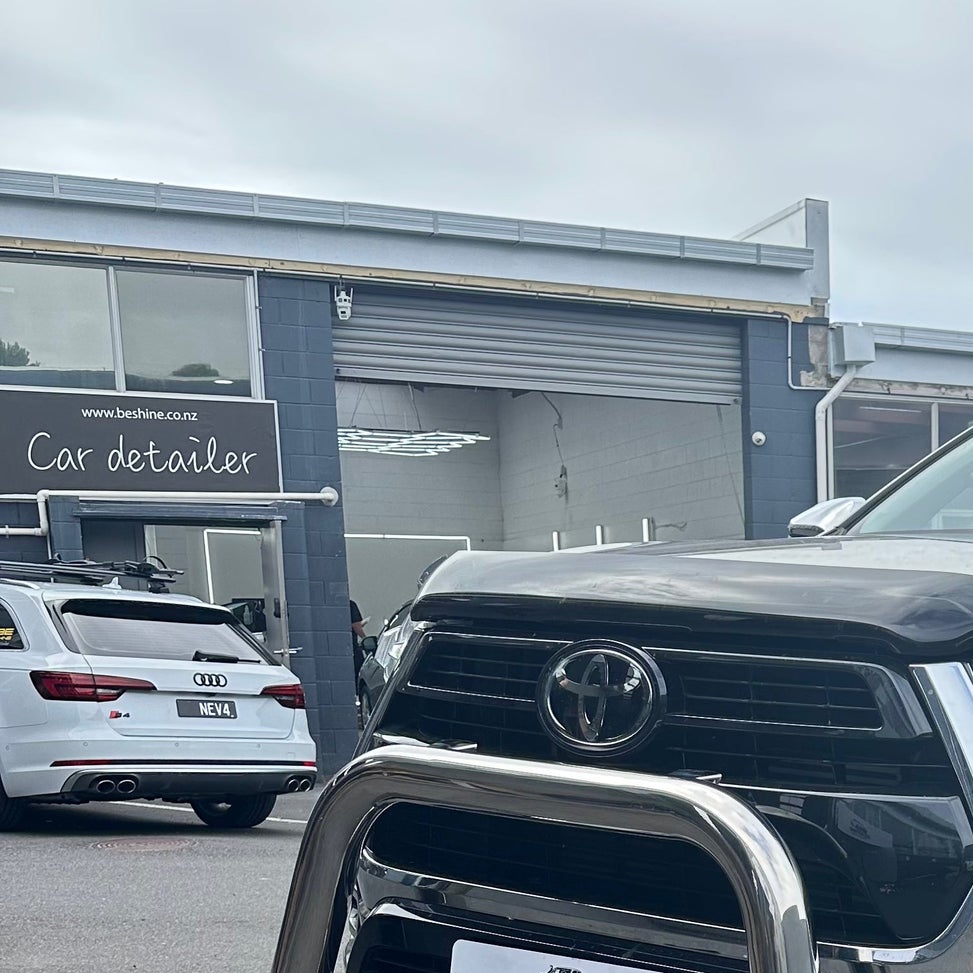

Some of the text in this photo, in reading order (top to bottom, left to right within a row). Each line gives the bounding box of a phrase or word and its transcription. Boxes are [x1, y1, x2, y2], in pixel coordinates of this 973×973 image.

[81, 407, 198, 421] www.beshine.co.nz
[27, 431, 258, 474] Car detailer
[199, 702, 231, 716] NEV4
